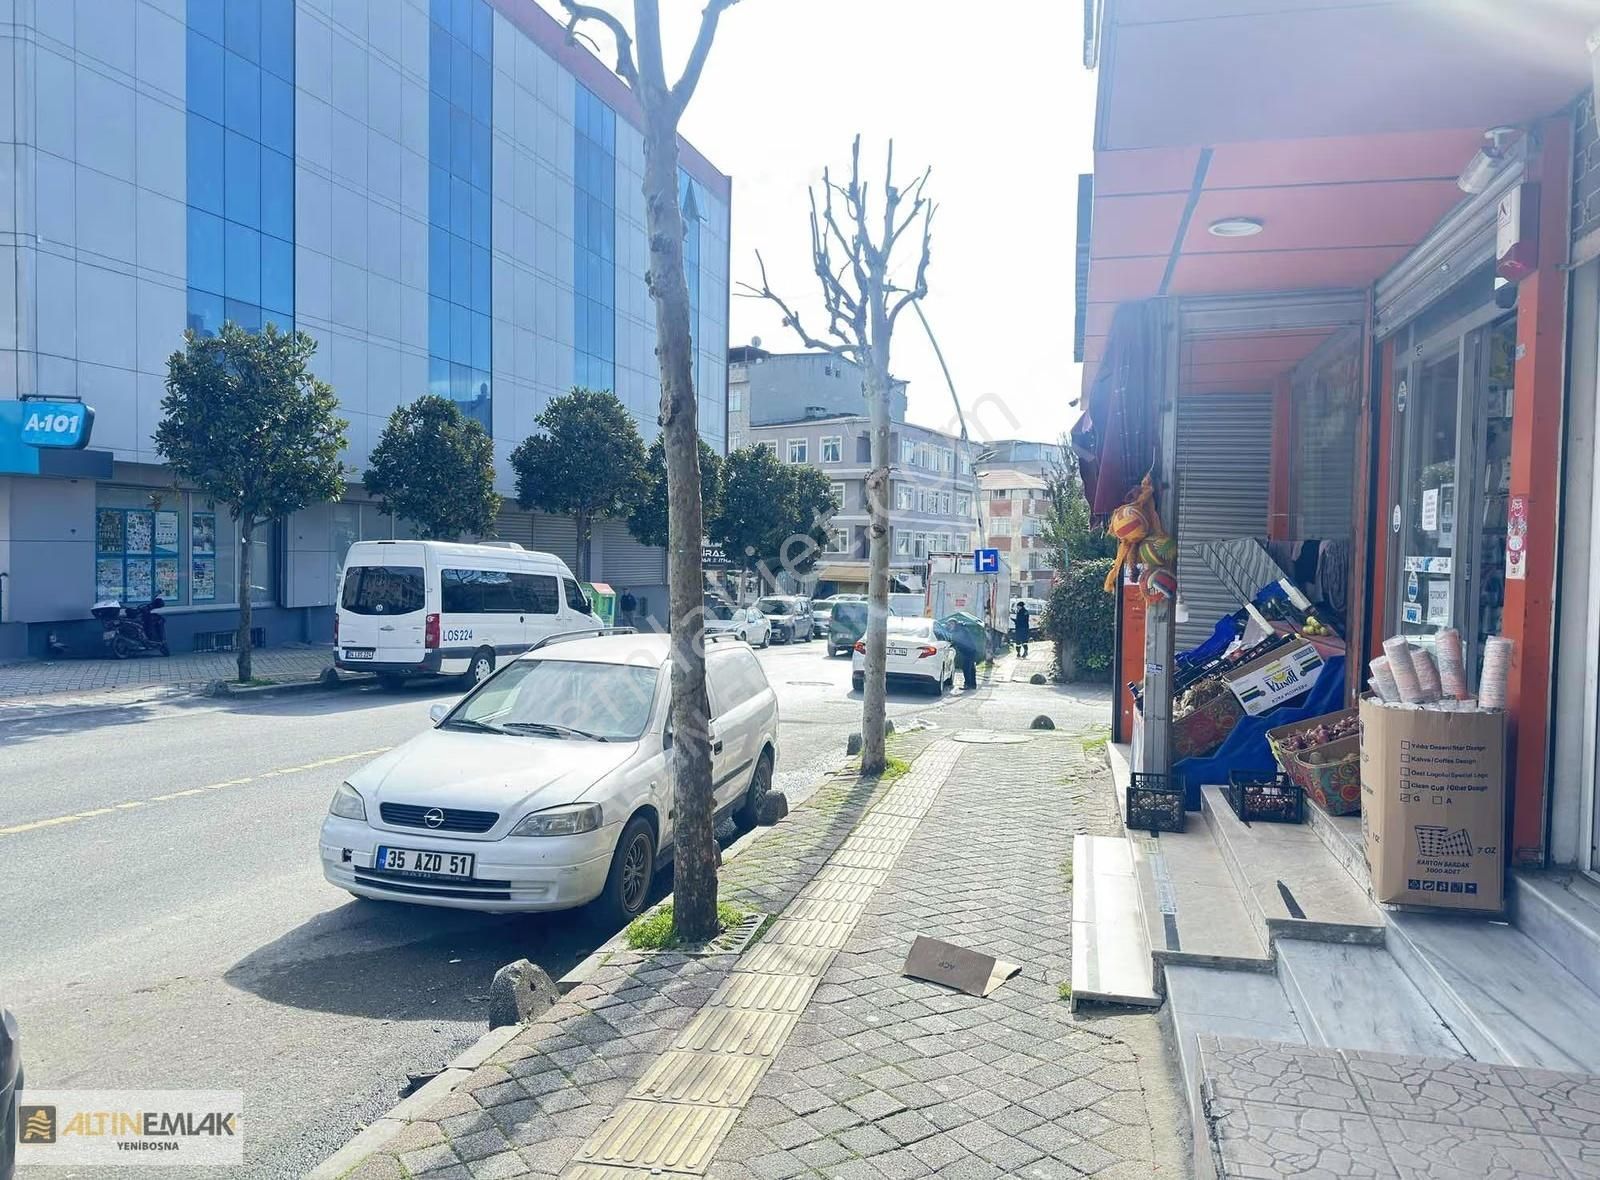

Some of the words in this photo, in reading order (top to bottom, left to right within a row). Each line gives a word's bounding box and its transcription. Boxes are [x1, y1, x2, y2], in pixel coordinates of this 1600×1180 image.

[443, 630, 473, 641] LOS224
[1266, 669, 1298, 692] BONITA
[388, 850, 406, 869] 35
[414, 853, 442, 872] AZD
[449, 856, 468, 875] 51
